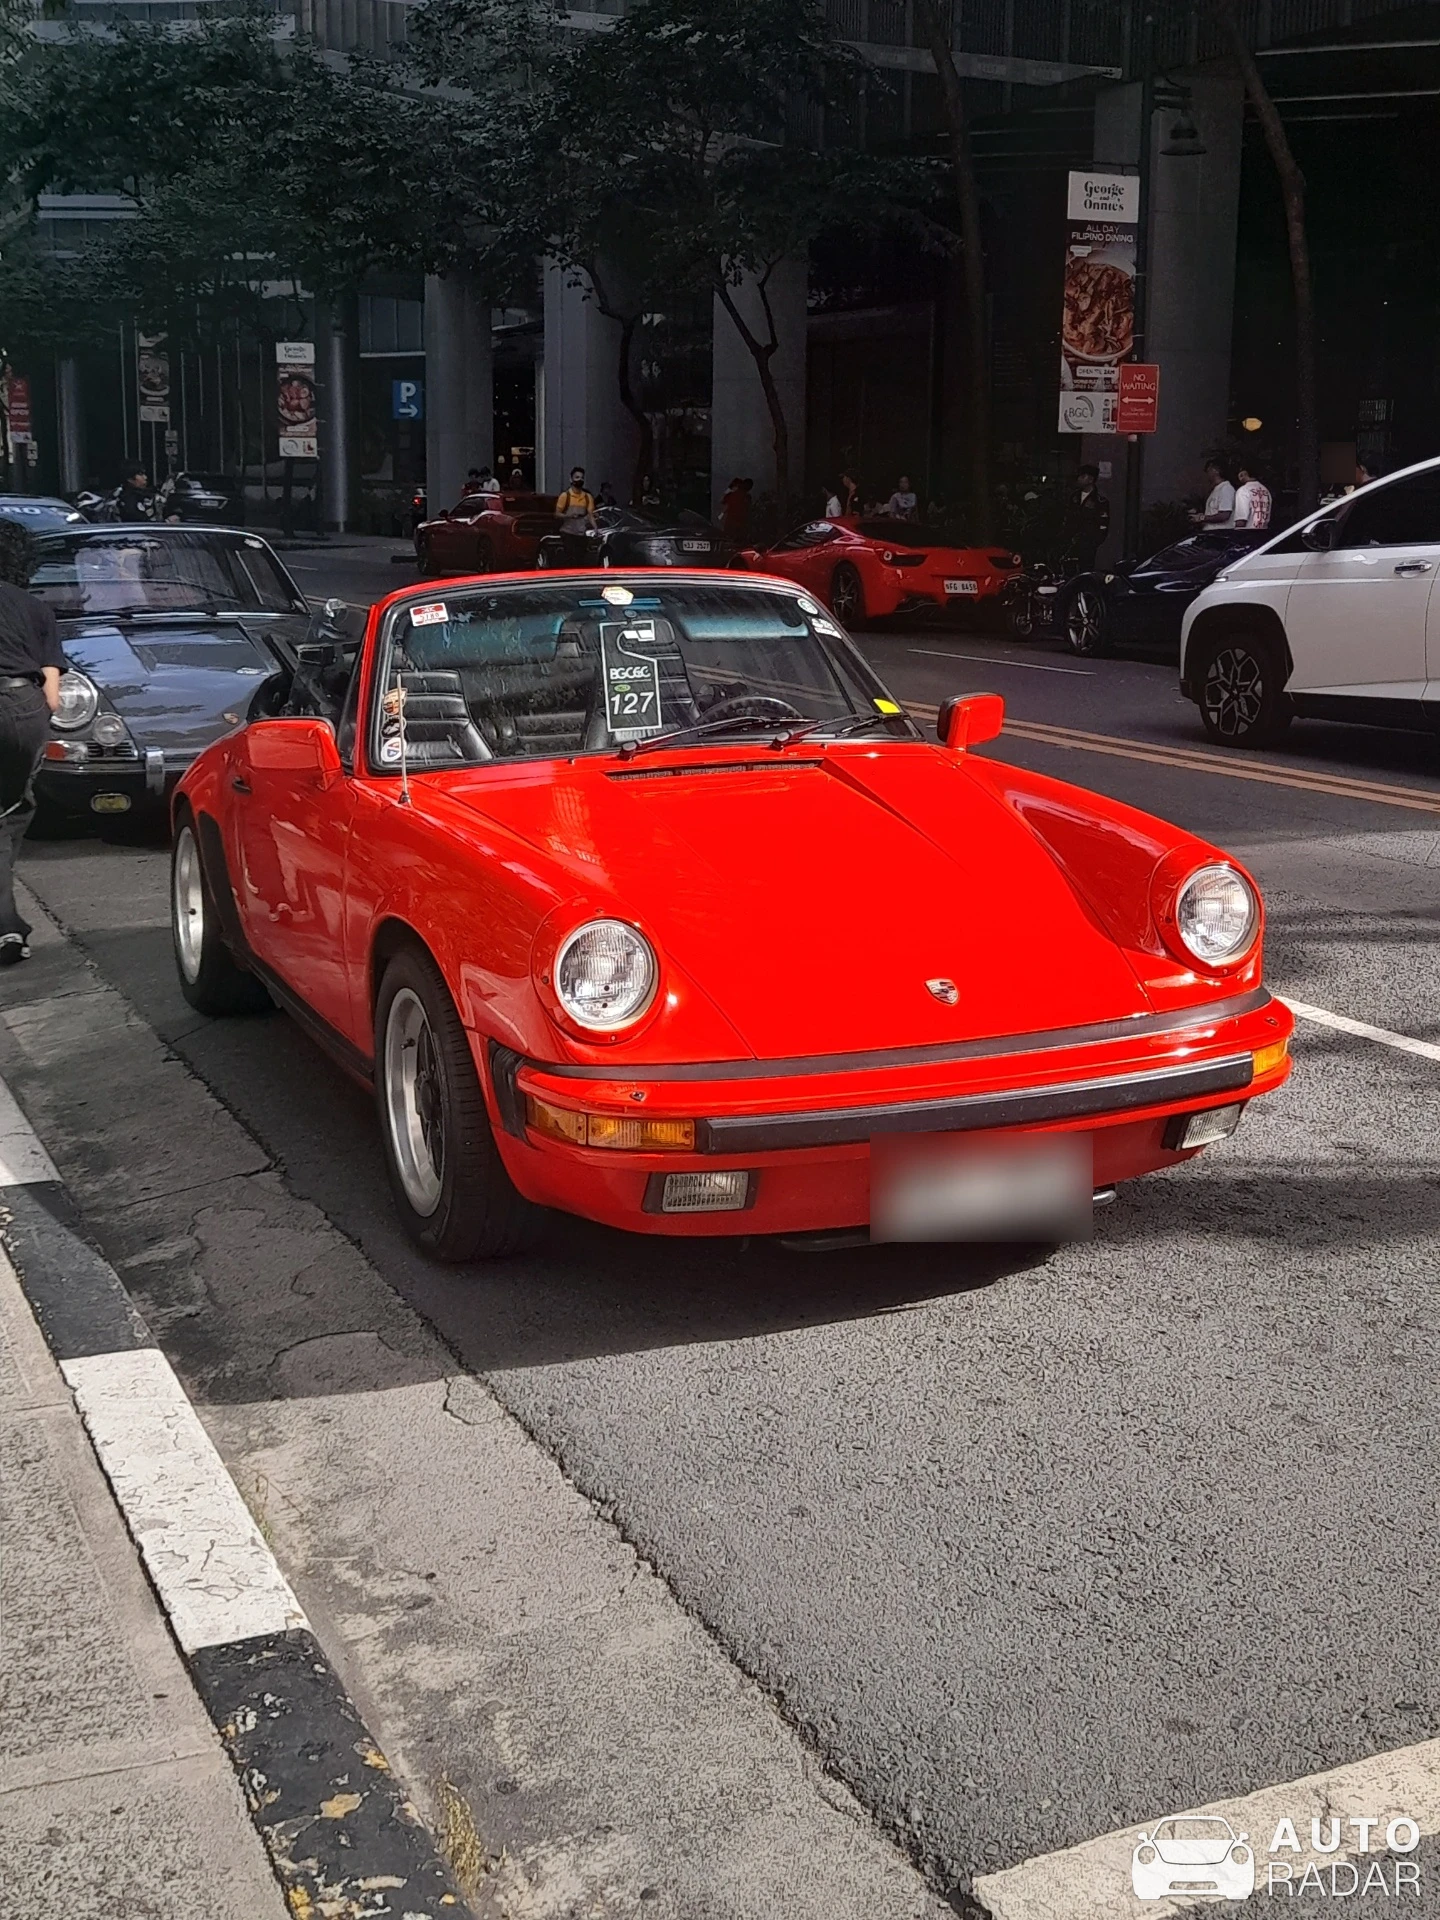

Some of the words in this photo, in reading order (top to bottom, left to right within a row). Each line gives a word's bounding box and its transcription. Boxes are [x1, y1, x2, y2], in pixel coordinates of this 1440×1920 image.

[1083, 181, 1125, 197] George
[1086, 224, 1101, 233] ALL
[1102, 225, 1120, 234] DAY
[1071, 232, 1104, 242] FILIPINO
[1105, 234, 1134, 243] DINING
[1133, 373, 1146, 382] NO
[1121, 382, 1156, 391] WAITING
[401, 382, 416, 403] P
[1068, 407, 1089, 418] BGC
[1102, 422, 1116, 430] Tag
[610, 691, 655, 715] 127
